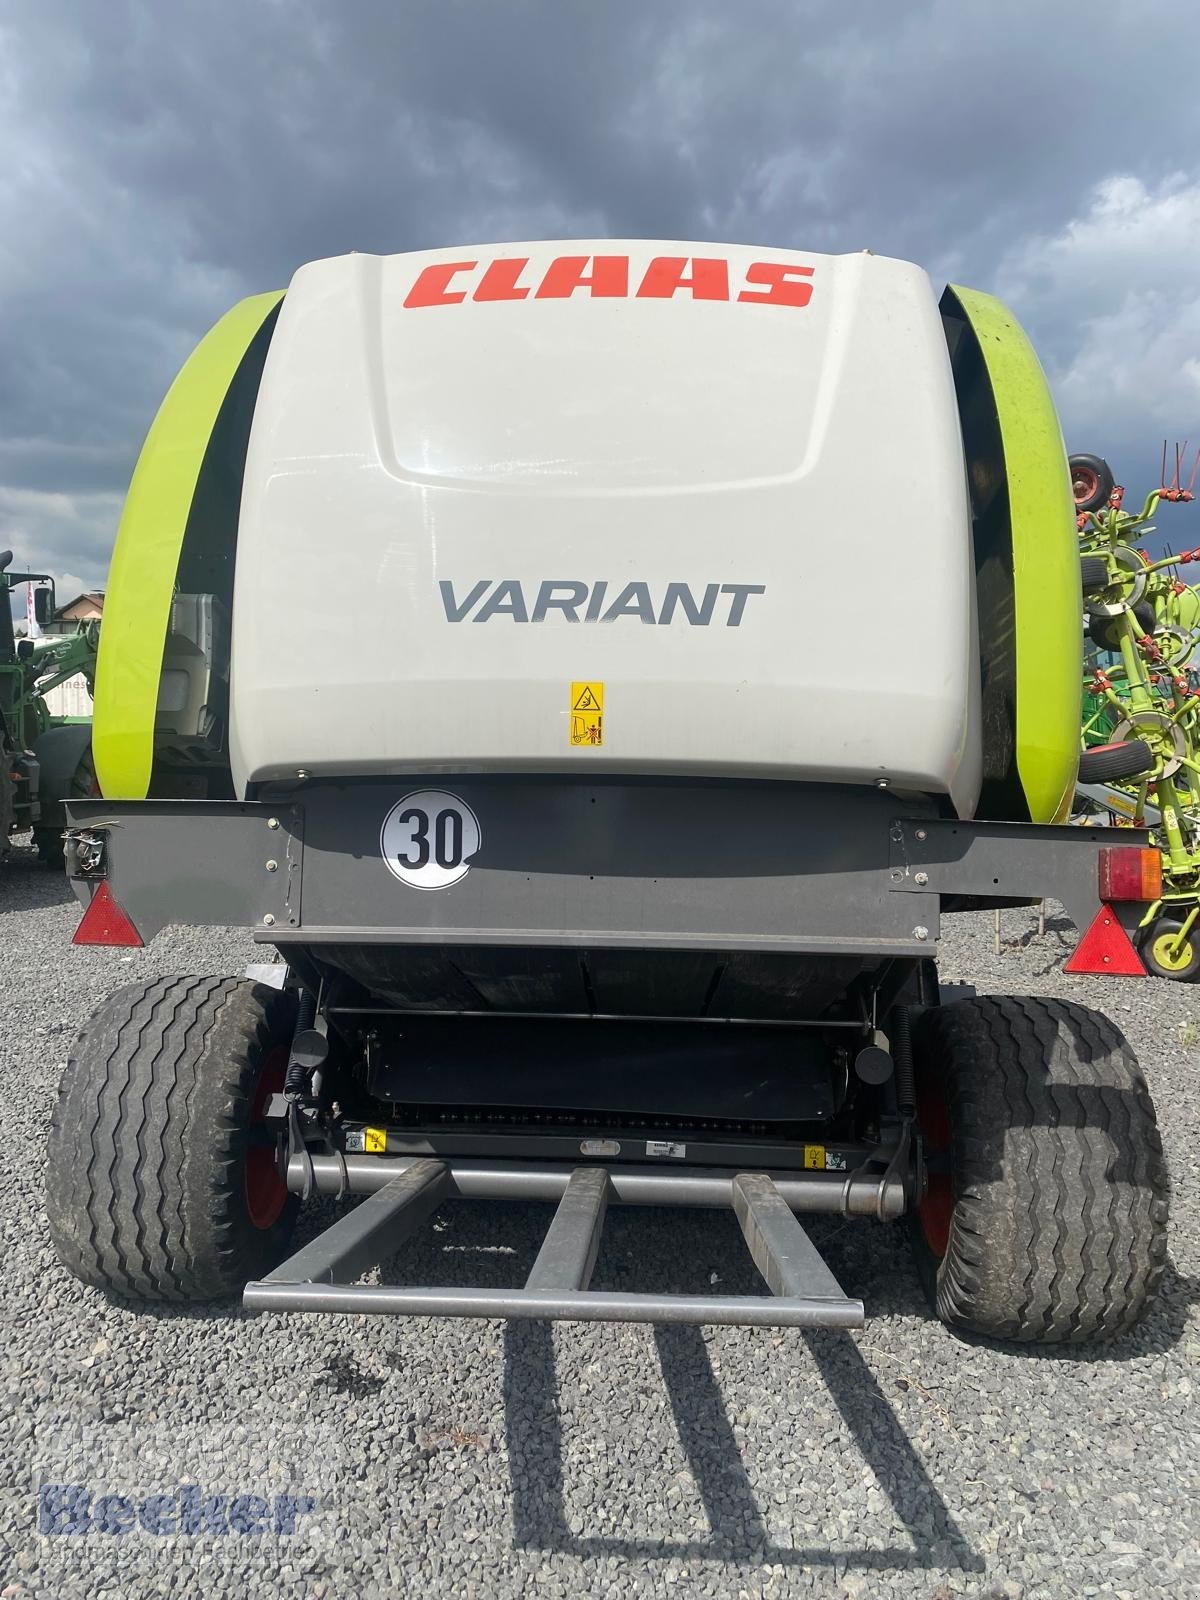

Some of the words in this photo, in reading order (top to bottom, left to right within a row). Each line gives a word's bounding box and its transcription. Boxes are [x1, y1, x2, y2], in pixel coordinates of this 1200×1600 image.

[404, 257, 814, 307] CLAAS
[439, 581, 765, 627] VARIANT
[397, 809, 463, 870] 30
